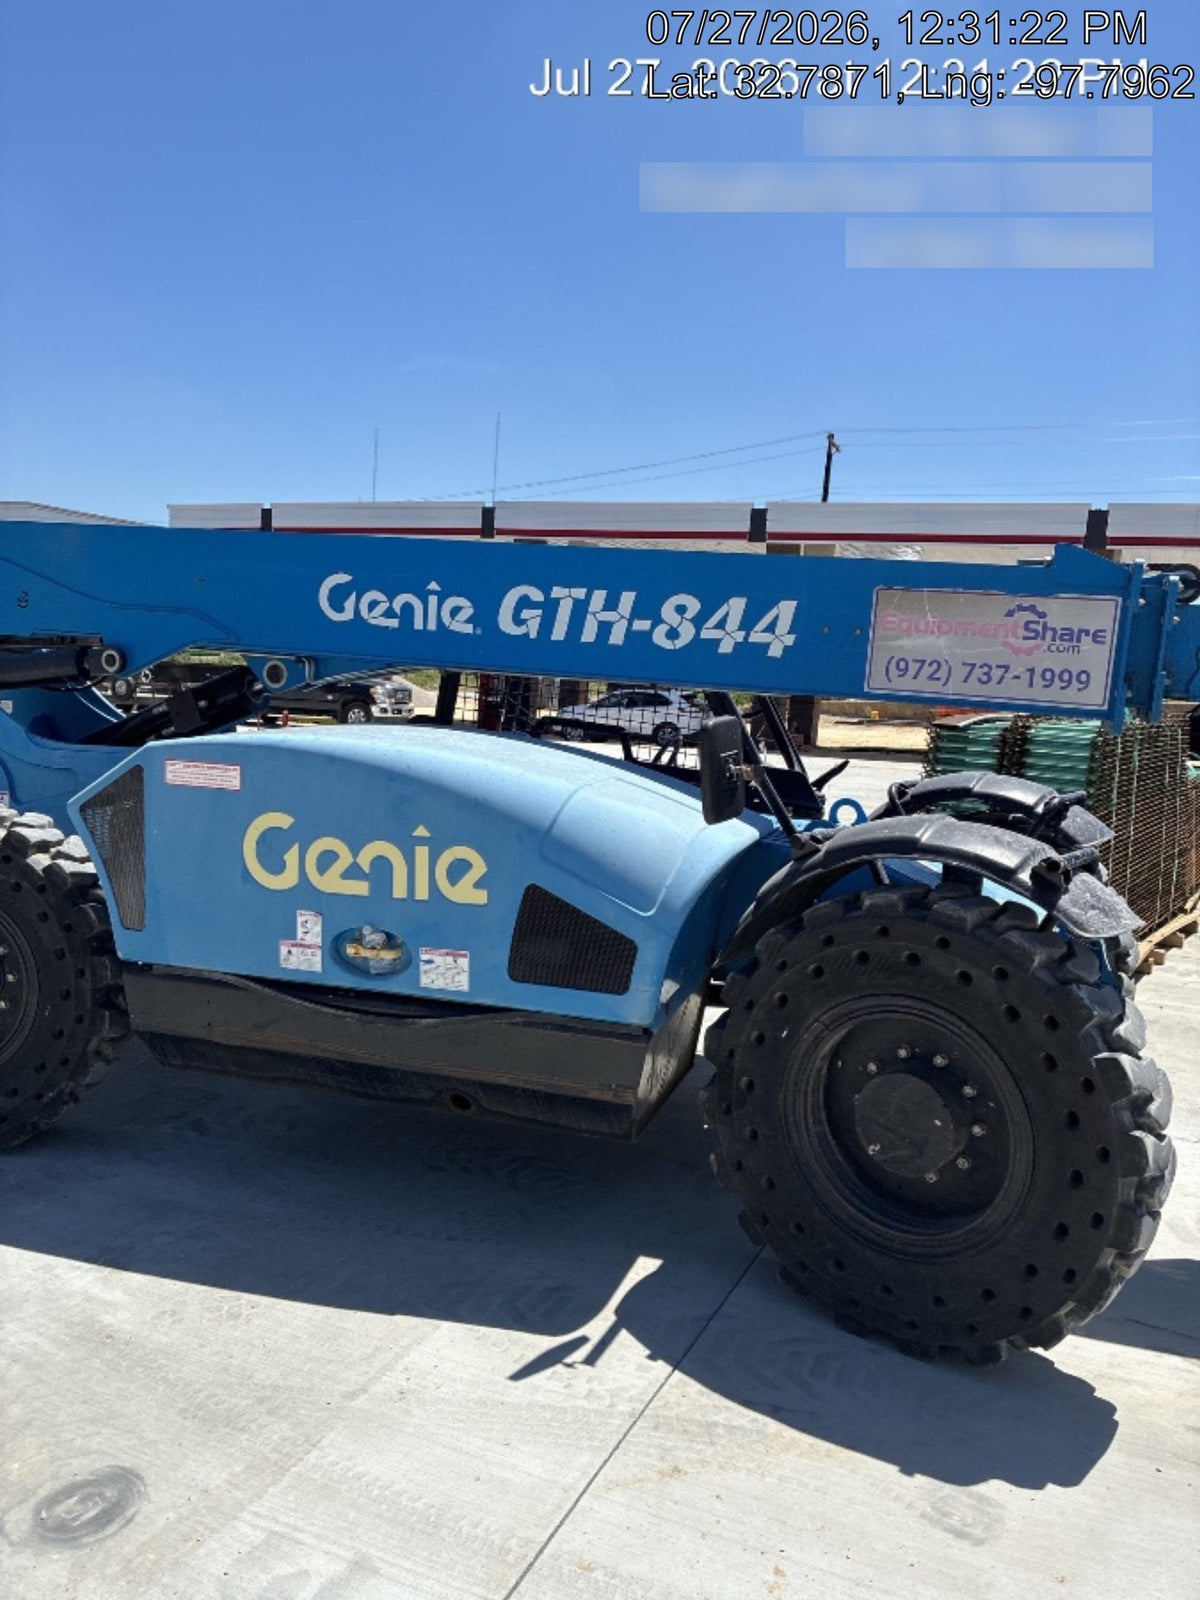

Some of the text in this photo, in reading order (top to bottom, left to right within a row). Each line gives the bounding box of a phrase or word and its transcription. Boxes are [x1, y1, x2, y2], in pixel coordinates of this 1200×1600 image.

[318, 572, 798, 659] Genie GTH-844
[885, 655, 1091, 692] (972) 737-1999
[1042, 643, 1080, 655] .com
[243, 811, 488, 906] Genie
